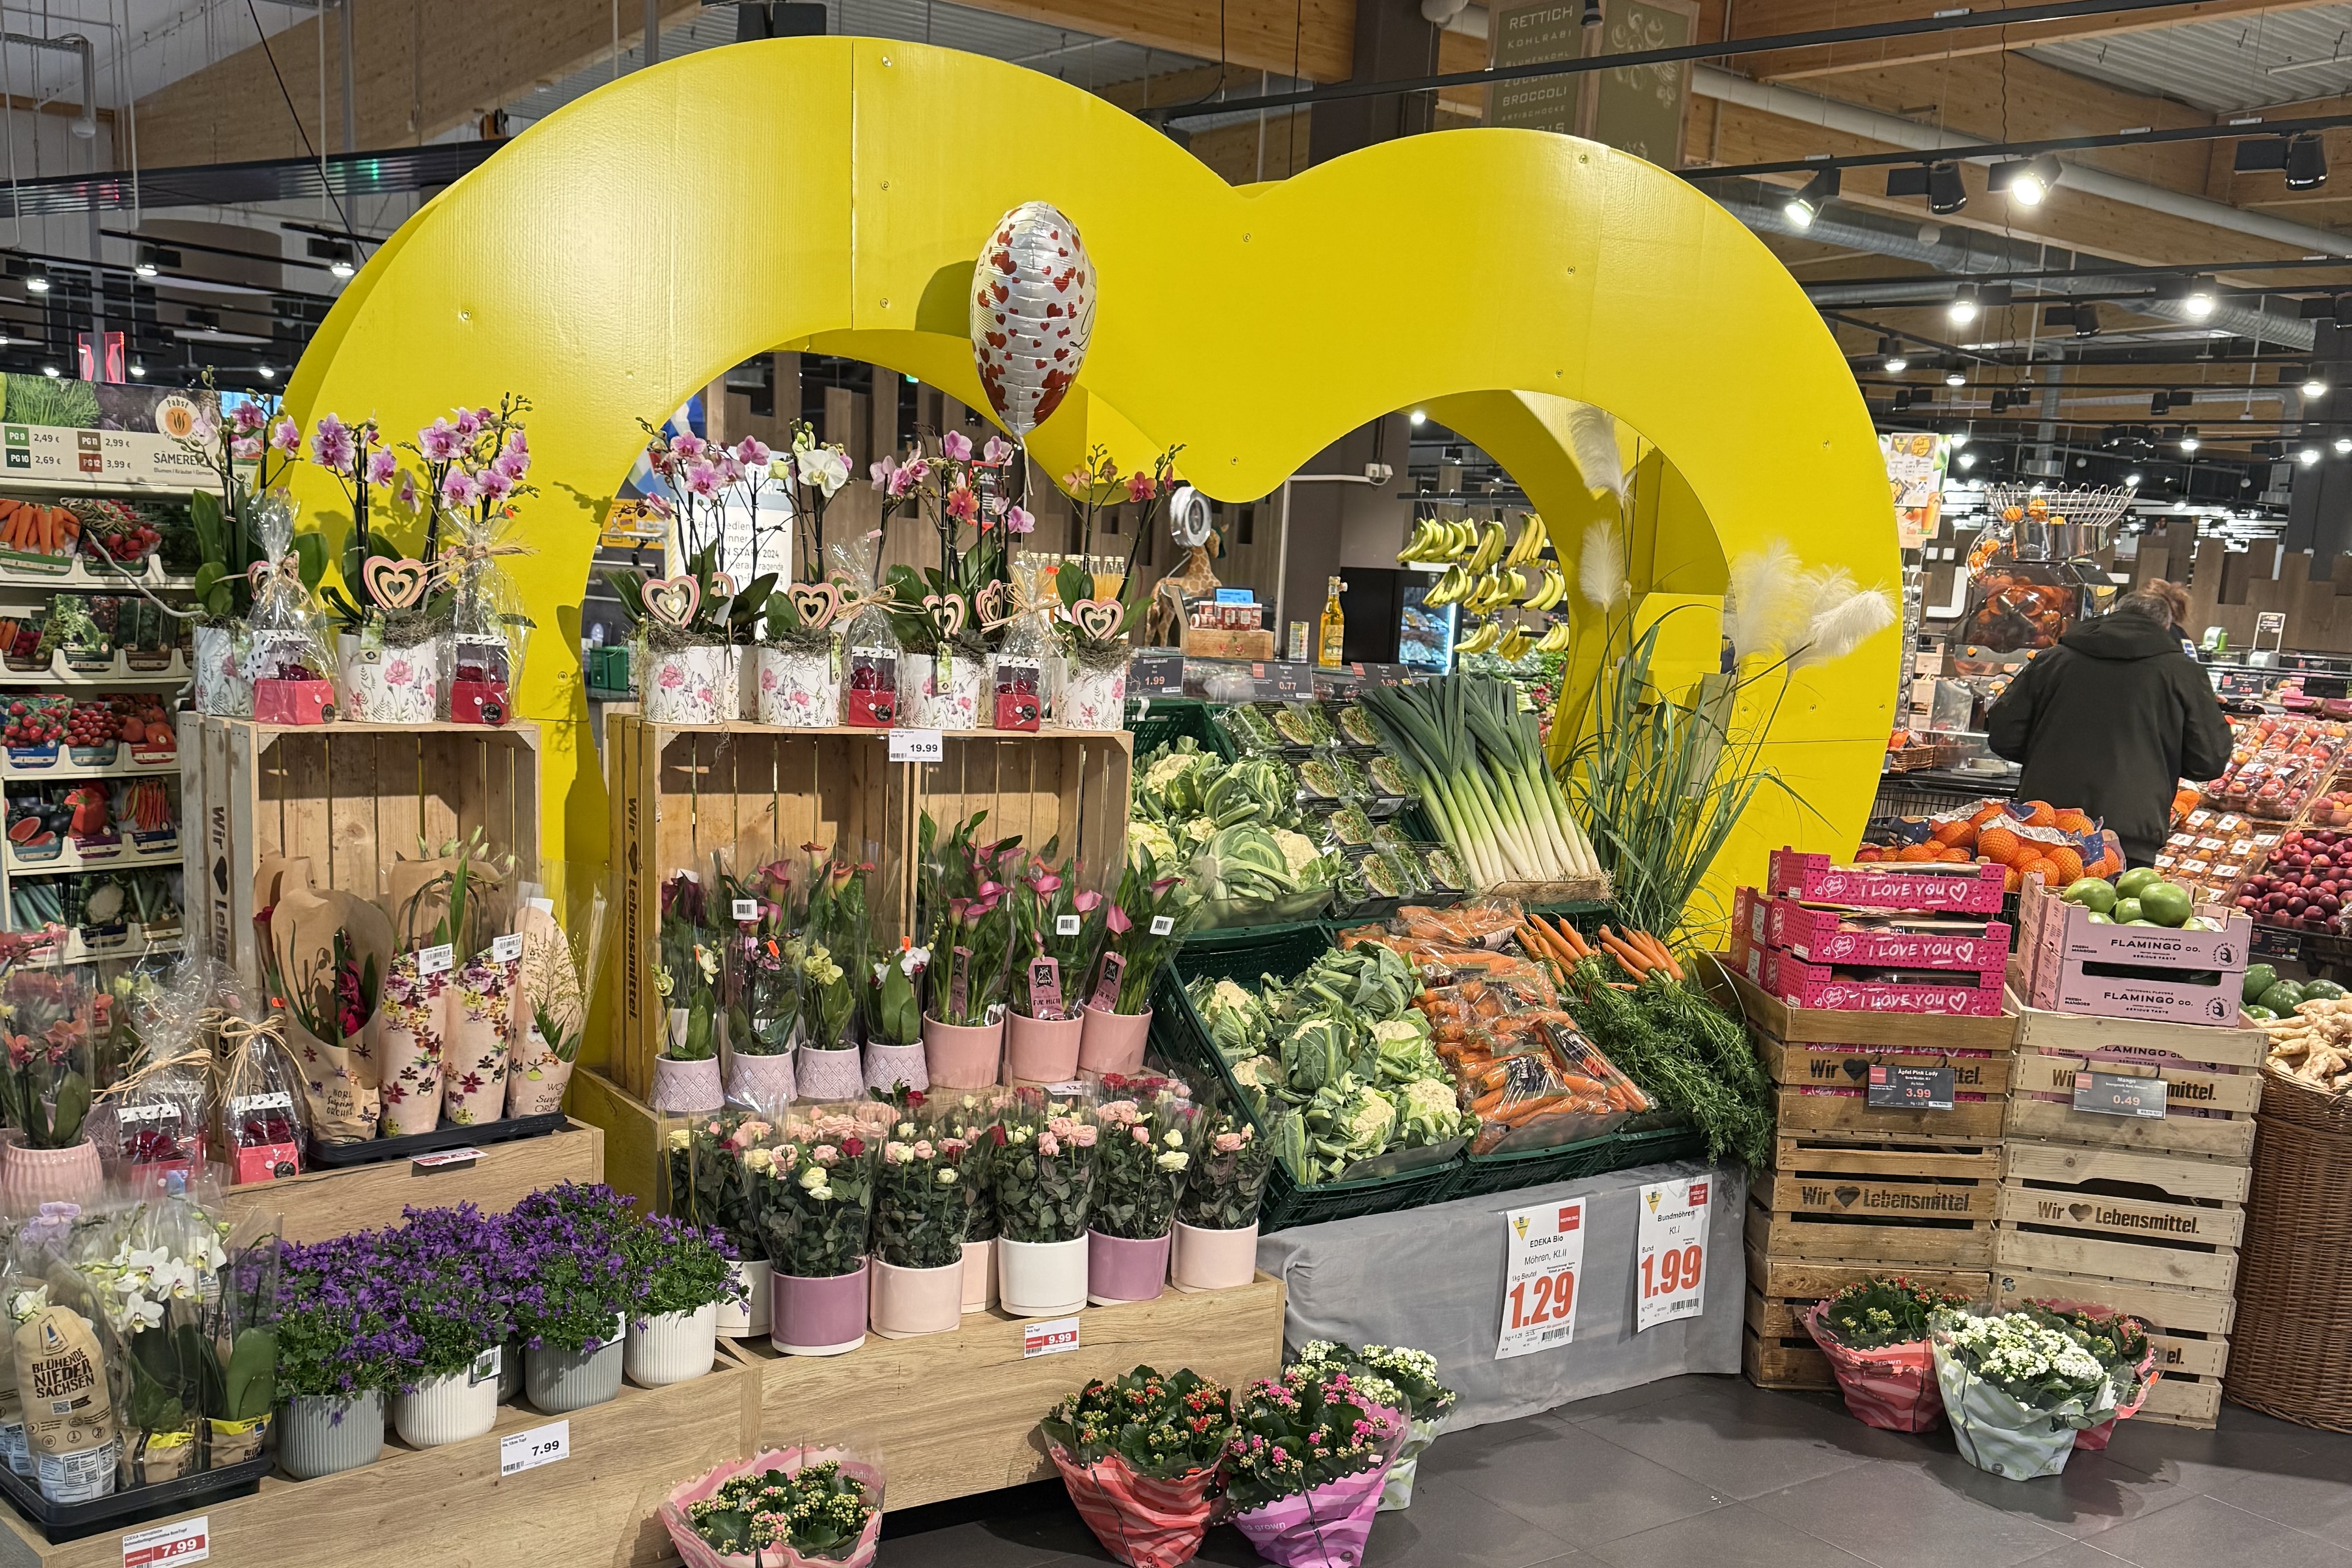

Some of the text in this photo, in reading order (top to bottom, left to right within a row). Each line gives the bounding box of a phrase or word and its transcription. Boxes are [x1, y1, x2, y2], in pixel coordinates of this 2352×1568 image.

[1510, 5, 1573, 30] RETTICH
[1508, 30, 1571, 48] KOHLRABI
[1503, 86, 1567, 106] BROCCOLI
[166, 398, 189, 408] Pabst
[34, 434, 53, 443] 2,49
[105, 439, 124, 447] 2,99
[35, 456, 54, 464] 2,69
[107, 460, 125, 468] 3,99
[763, 549, 779, 558] 2024
[1145, 676, 1165, 686] 1.99
[1279, 681, 1296, 690] 0.77
[910, 744, 938, 753] 19.99
[212, 807, 226, 850] Wir
[1861, 883, 1945, 897] I LOVE YOU
[1869, 943, 1952, 957] I LOVE YOU
[2111, 939, 2181, 951] FLAMINGO
[1861, 993, 1944, 1008] I LOVE YOU
[2104, 992, 2174, 1004] FLAMINGO
[2097, 1045, 2166, 1056] LAMINGO
[1810, 1059, 1839, 1079] Wir
[2053, 1069, 2075, 1088] Wi
[1906, 1088, 1931, 1098] 3.99
[2113, 1095, 2140, 1106] 0.49
[1802, 1186, 1972, 1212] Wir Lebensmittel.
[1658, 1210, 1695, 1222] Bundmöhren
[2038, 1201, 2200, 1234] Wir Lebensmittel.
[1530, 1236, 1552, 1248] EDEKA
[1524, 1253, 1551, 1265] Möhren,
[1642, 1245, 1703, 1299] 1.99
[1509, 1271, 1575, 1329] 1.29
[1048, 1332, 1072, 1344] 9.99
[33, 1358, 93, 1388] NIEDER
[36, 1373, 95, 1399] SACHSEN
[531, 1440, 559, 1457] 7.99
[1255, 1522, 1286, 1532] grown
[161, 1538, 197, 1557] 7.99
